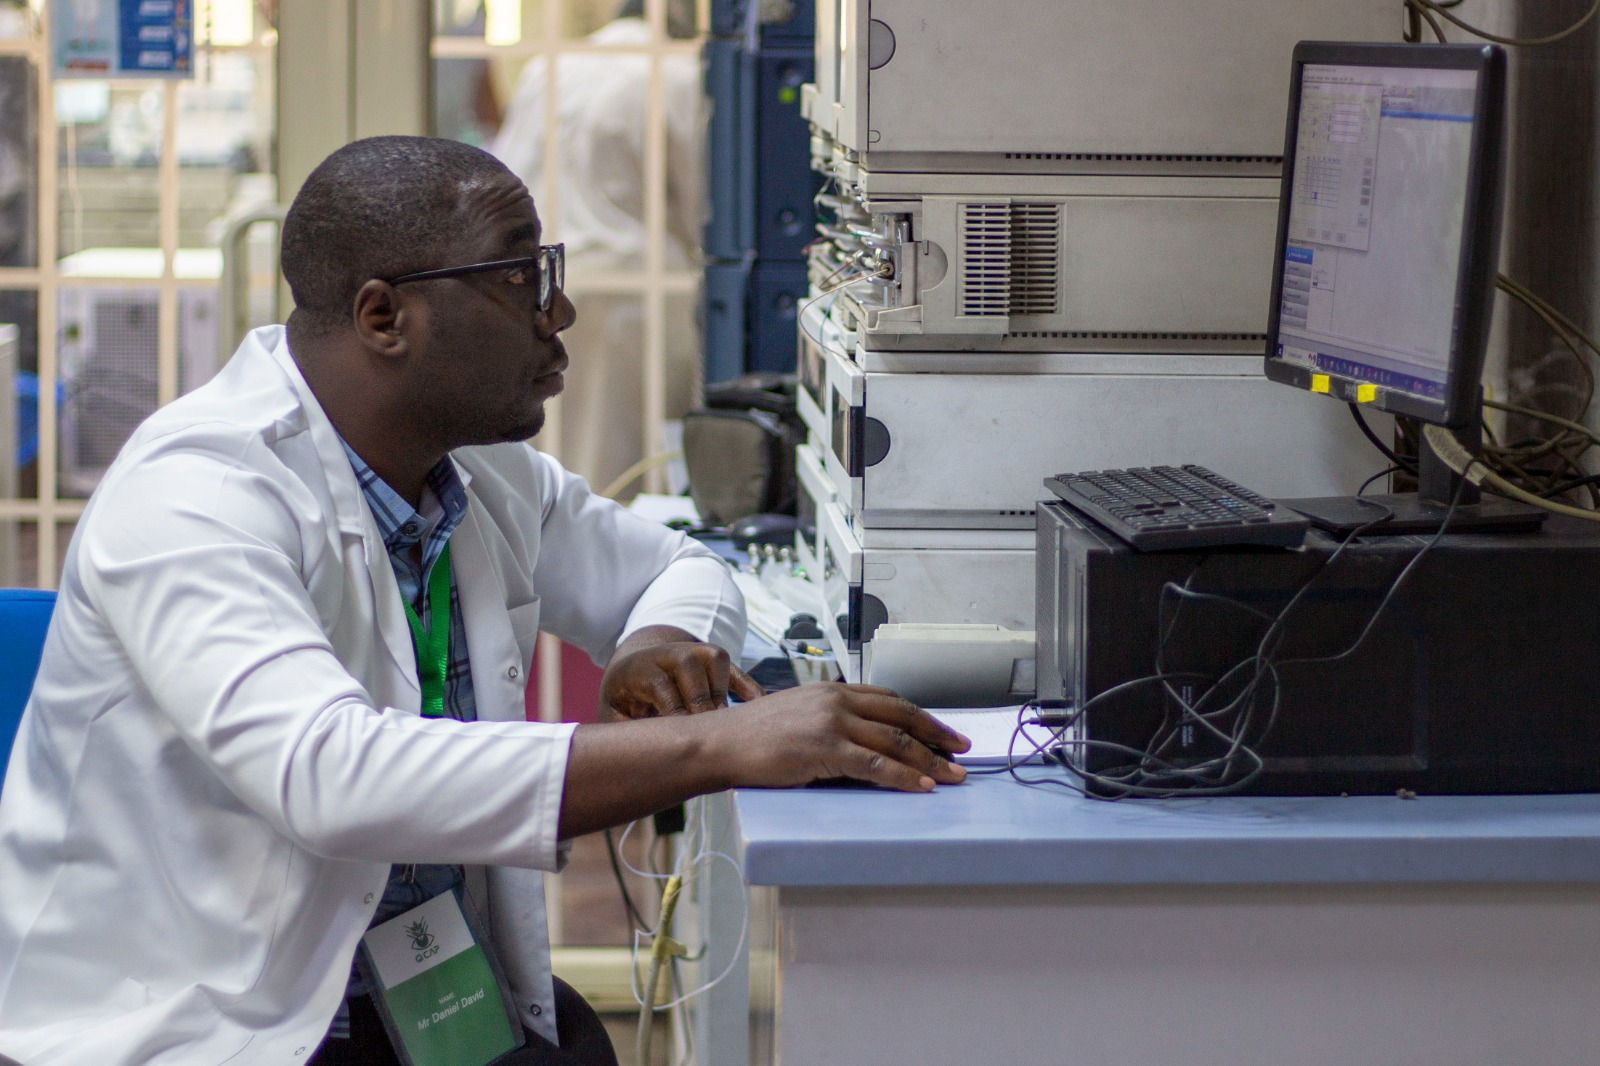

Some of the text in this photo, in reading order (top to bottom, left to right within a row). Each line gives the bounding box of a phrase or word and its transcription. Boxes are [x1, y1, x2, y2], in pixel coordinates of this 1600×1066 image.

[417, 988, 485, 1030] Mr Daniel David
[438, 992, 455, 1004] NAME
